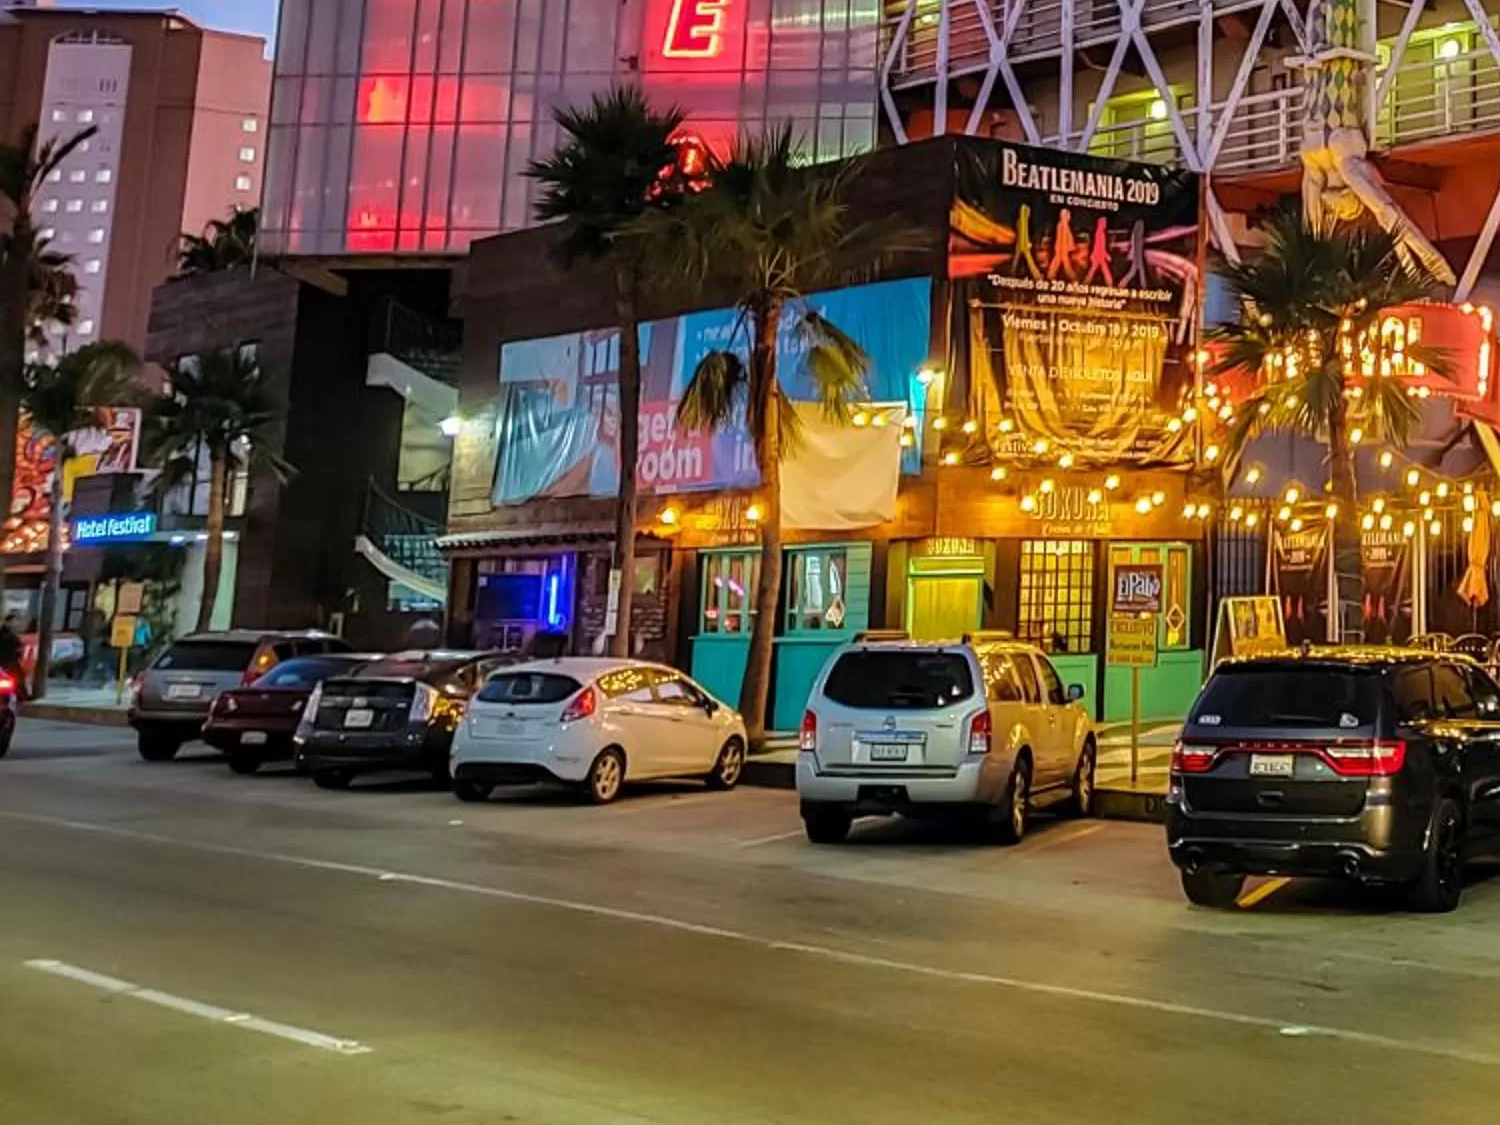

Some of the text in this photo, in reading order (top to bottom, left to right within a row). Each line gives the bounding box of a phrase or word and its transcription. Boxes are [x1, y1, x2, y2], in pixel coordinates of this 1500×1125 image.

[1001, 148, 1160, 205] BEATLEMANIA 2019
[1049, 193, 1120, 212] EN CONCIERTO
[1035, 279, 1049, 290] de
[1050, 280, 1065, 292] 20
[1066, 280, 1089, 294] años
[1138, 287, 1172, 301] escribir
[1037, 294, 1057, 304] una
[1002, 313, 1048, 331] Viernes
[1059, 318, 1107, 335] Octubre
[1131, 323, 1160, 338] 2019
[75, 518, 107, 540] Hotel
